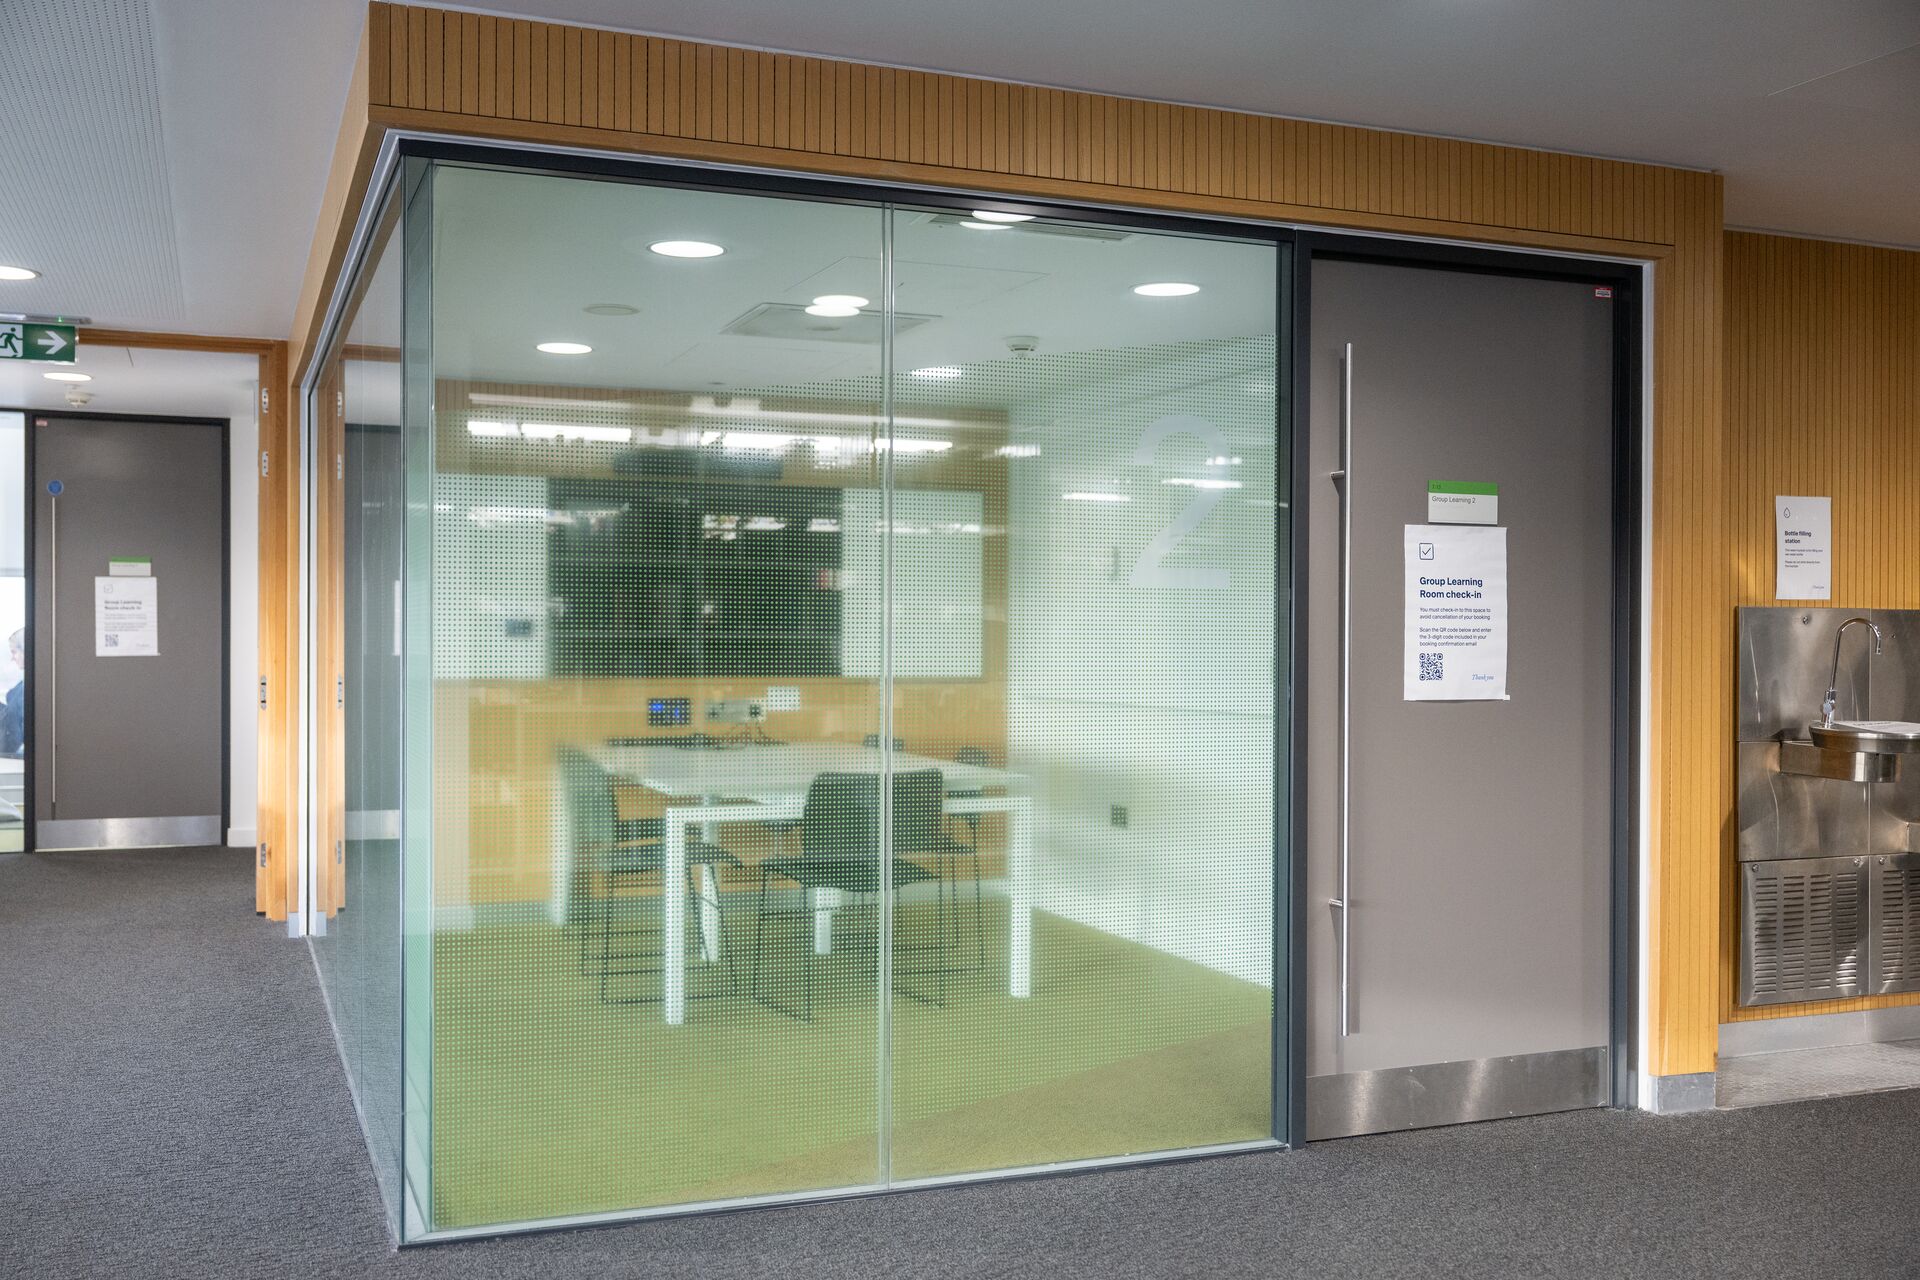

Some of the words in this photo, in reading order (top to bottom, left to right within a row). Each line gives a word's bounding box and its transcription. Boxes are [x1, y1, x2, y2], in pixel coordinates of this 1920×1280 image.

[1129, 414, 1230, 588] 2
[1431, 495, 1448, 503] Group
[1449, 496, 1471, 504] Learning
[1420, 576, 1446, 587] Group
[1447, 577, 1483, 588] Learning
[1420, 589, 1445, 599] Room
[1446, 590, 1482, 599] check-in
